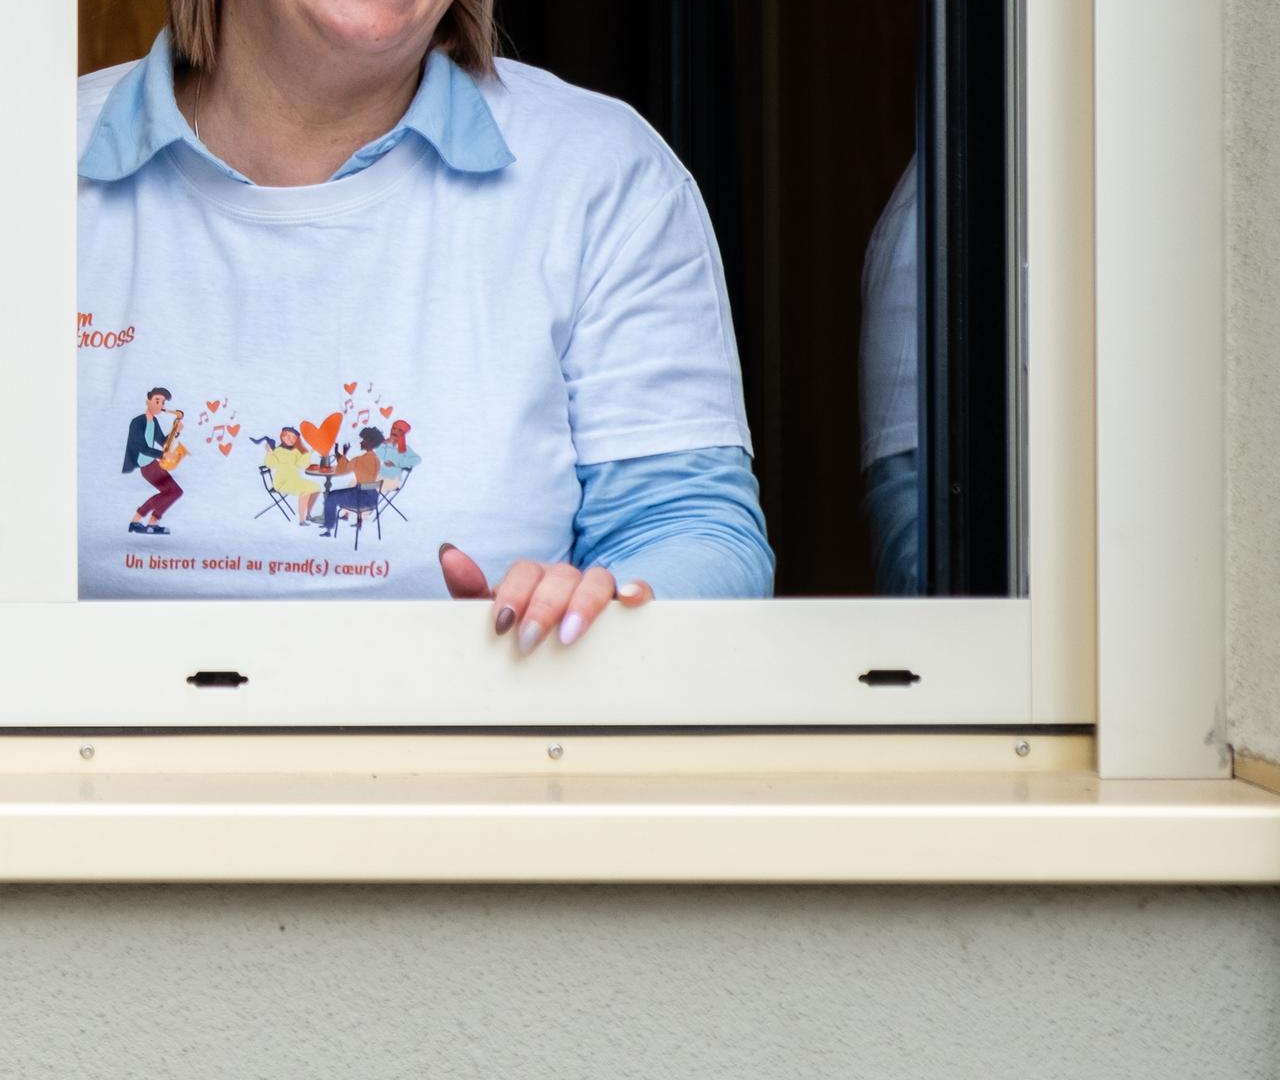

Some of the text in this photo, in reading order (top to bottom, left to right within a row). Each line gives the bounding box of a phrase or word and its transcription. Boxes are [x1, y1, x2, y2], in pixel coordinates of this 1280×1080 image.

[126, 554, 389, 577] Un bistrot social au grand(s) cœur(s)
